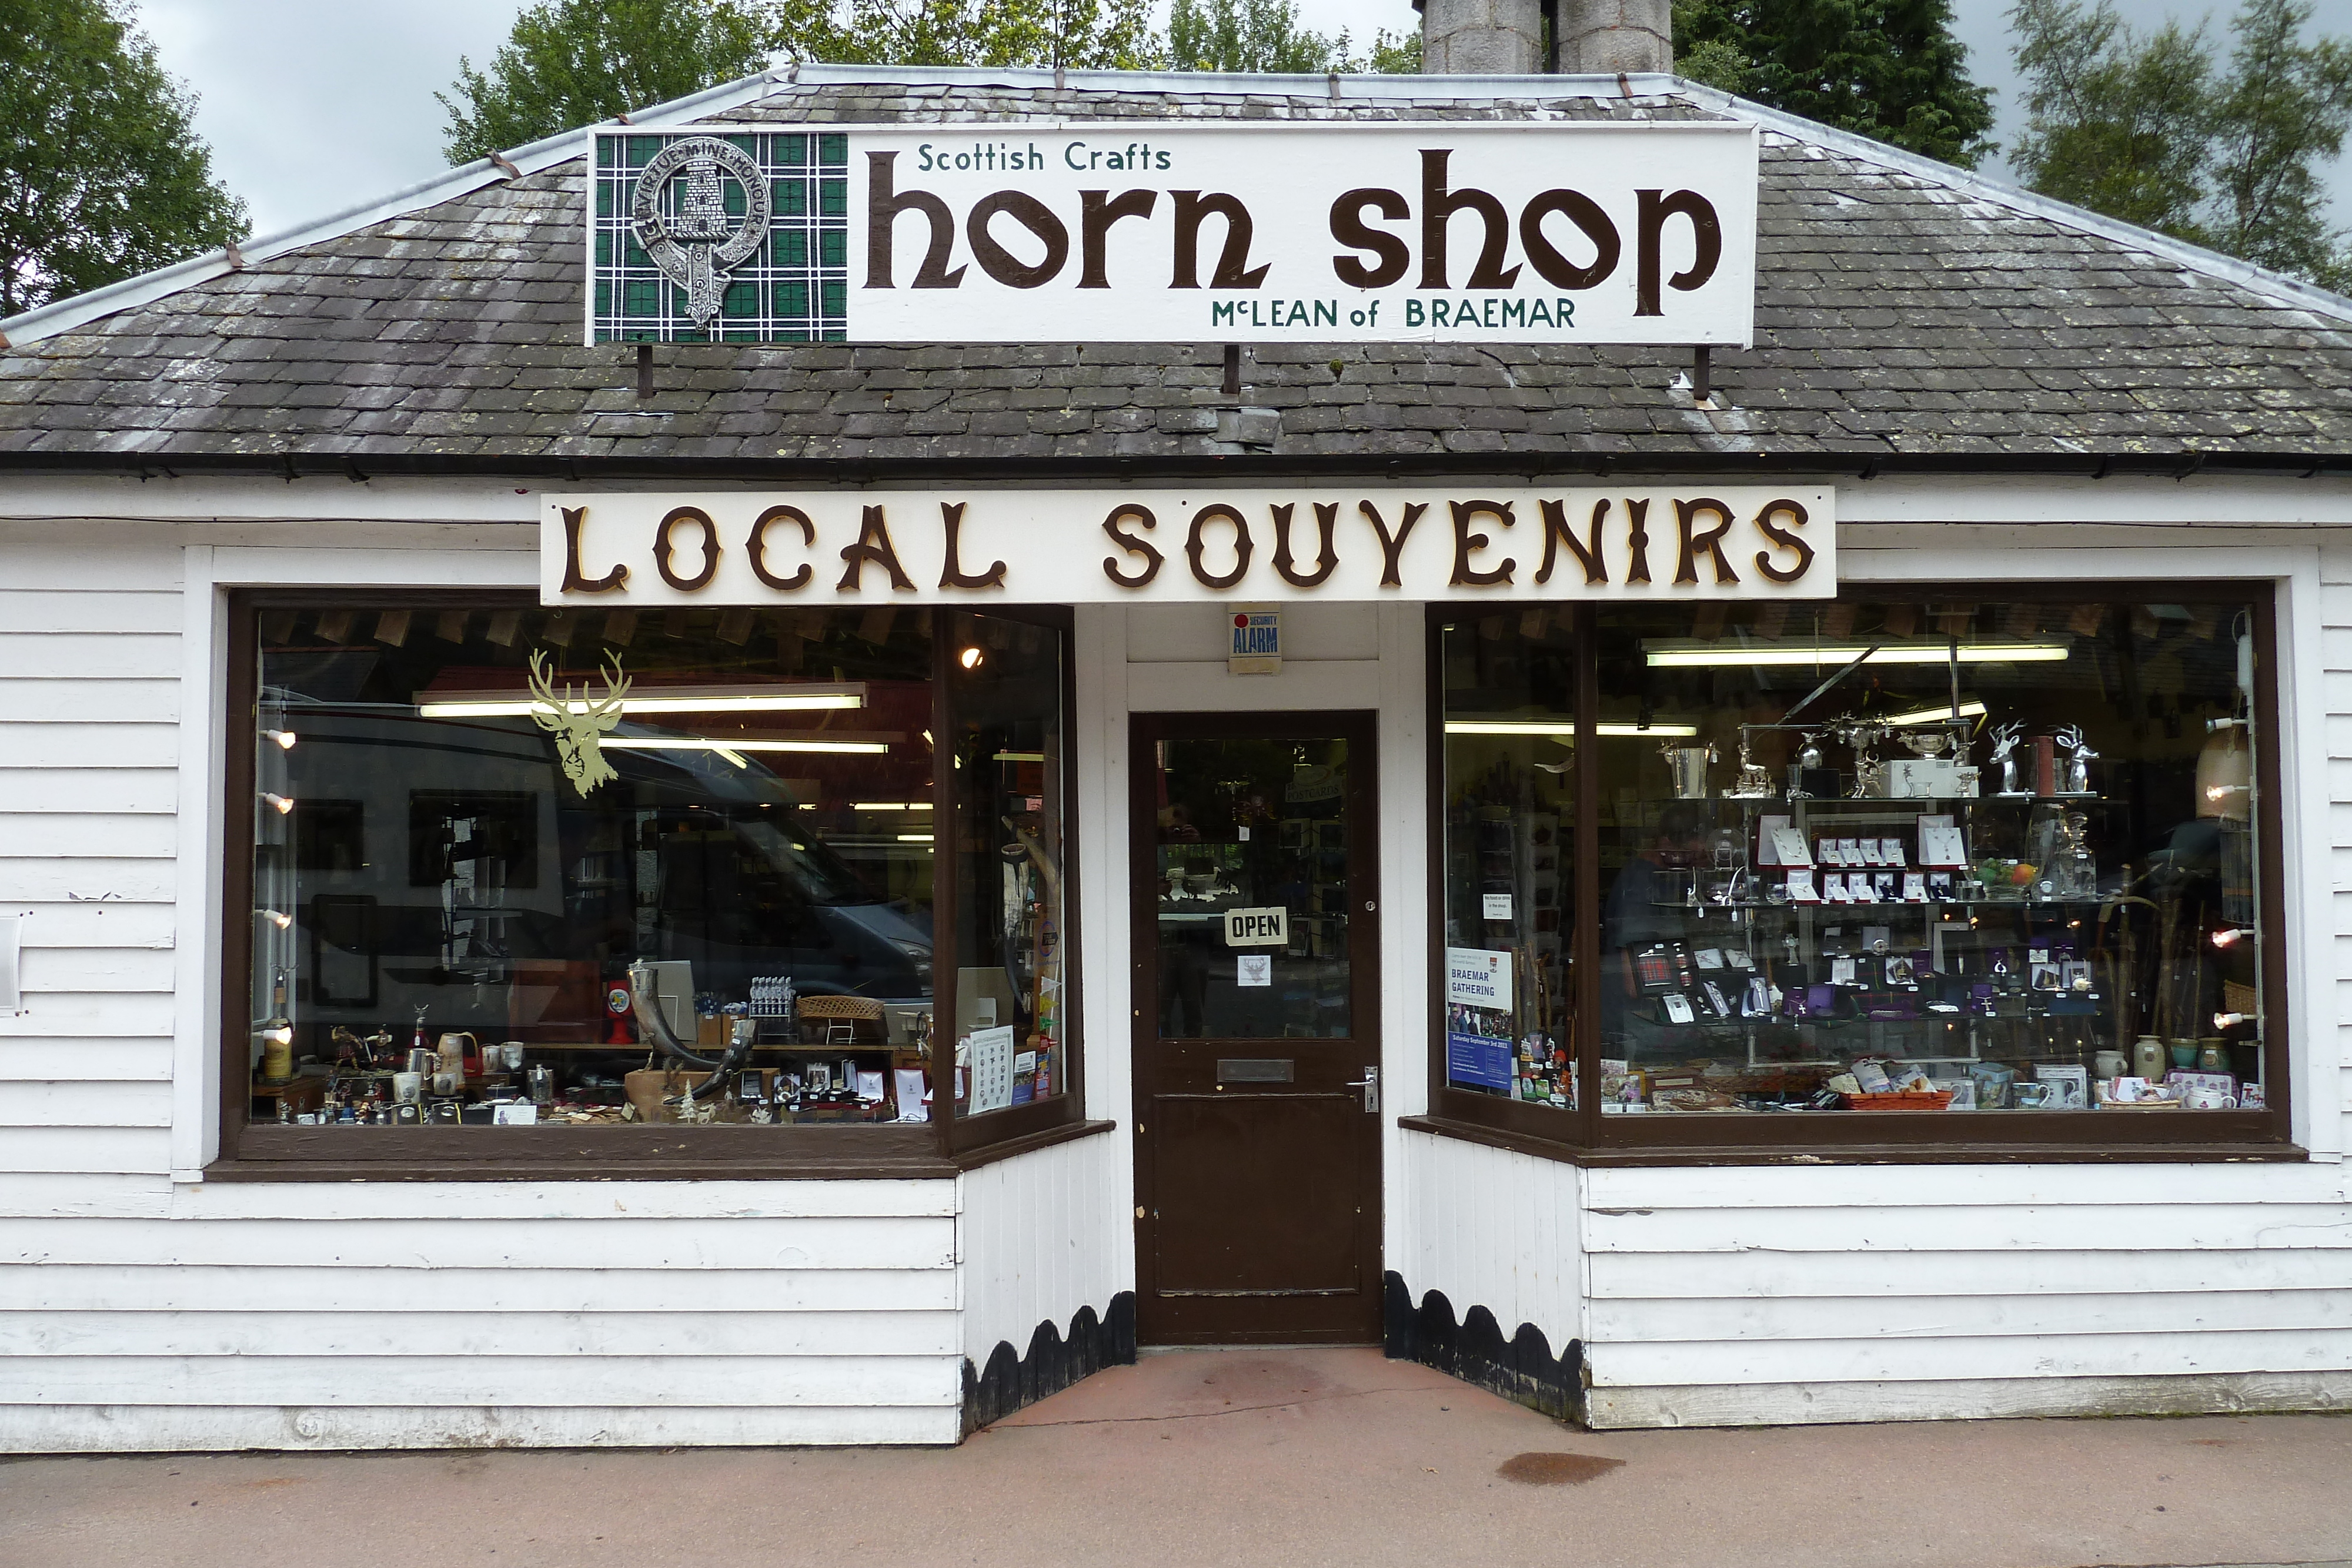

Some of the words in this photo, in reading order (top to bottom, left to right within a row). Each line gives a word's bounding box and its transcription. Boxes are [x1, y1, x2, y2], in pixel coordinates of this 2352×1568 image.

[918, 143, 1044, 171] Scottish
[1064, 142, 1171, 170] Crafts
[637, 150, 679, 206] VIRTUE
[685, 143, 729, 160] MINE
[733, 156, 765, 225] HONOUR
[861, 151, 1272, 289] horn
[1329, 149, 1722, 317] shop
[1212, 299, 1338, 327] McLEAN
[1349, 299, 1380, 327] of
[1406, 297, 1576, 328] BRAEMAR
[560, 502, 1008, 592] LOCAL
[1250, 616, 1277, 626] SECURITY
[1233, 627, 1278, 654] ALARM
[1287, 786, 1339, 801] POSTCARDS
[1232, 915, 1281, 938] OPEN
[1452, 968, 1489, 982] BRAEMAR
[1452, 982, 1495, 997] GATHERING
[1453, 1035, 1469, 1043] Saturday
[1470, 1037, 1490, 1045] September
